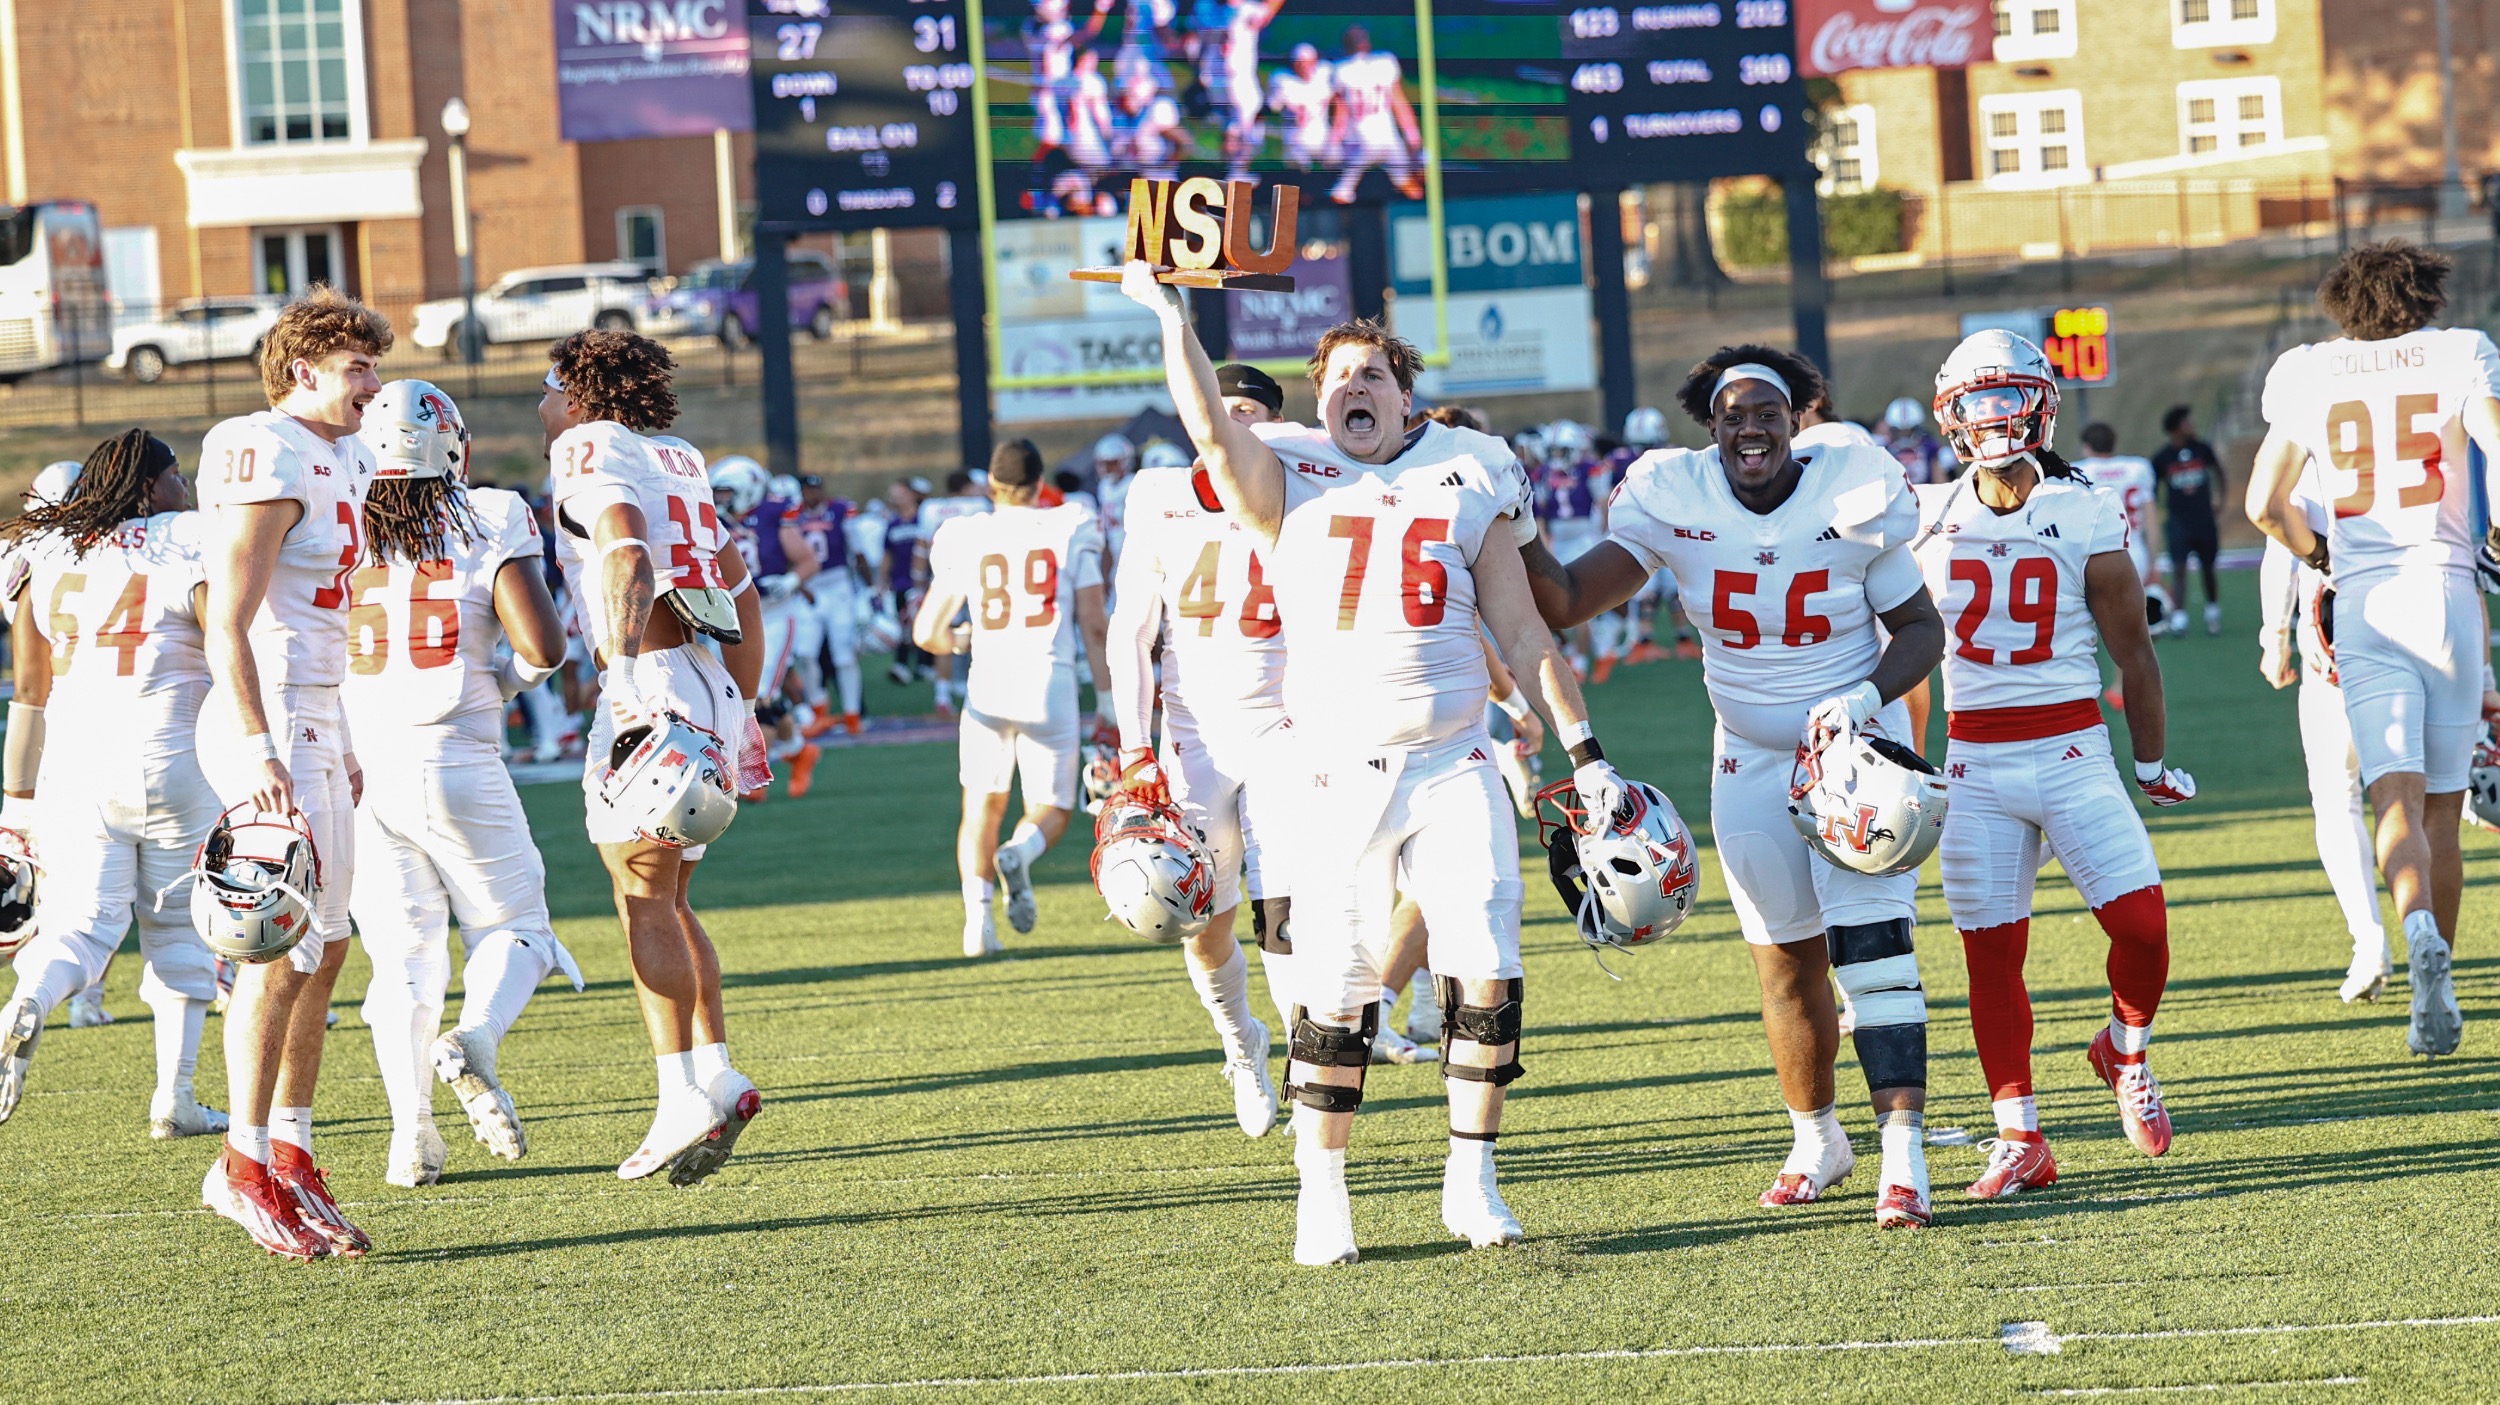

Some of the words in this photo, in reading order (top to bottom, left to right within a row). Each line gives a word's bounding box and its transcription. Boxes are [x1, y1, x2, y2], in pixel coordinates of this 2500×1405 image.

[573, 0, 727, 45] NRMC
[913, 14, 956, 52] 31
[1632, 3, 1722, 31] RUSHING
[777, 22, 822, 61] 27
[772, 71, 837, 98] DOWN
[1646, 58, 1713, 85] TOTAL
[826, 124, 881, 152] BALL
[881, 122, 918, 148] ON
[1623, 107, 1742, 139] TURNOVERS
[935, 181, 957, 209] 2
[1124, 177, 1300, 275] NSU
[1448, 221, 1575, 267] BOM
[2044, 336, 2109, 381] 40
[2330, 346, 2425, 376] COLLINS
[224, 448, 256, 484] 30
[314, 465, 331, 477] SLC
[565, 441, 595, 478] 32
[654, 447, 702, 478] MILTON
[1298, 462, 1338, 478] SLC
[2326, 393, 2445, 519] 95
[1164, 510, 1196, 518] SLC
[1674, 528, 1713, 541] SLC
[312, 501, 367, 612] 3
[1328, 514, 1451, 631] 76
[979, 547, 1057, 630] 89
[348, 557, 460, 676] 66
[1712, 568, 1831, 649] 56
[1949, 556, 2058, 665] 29
